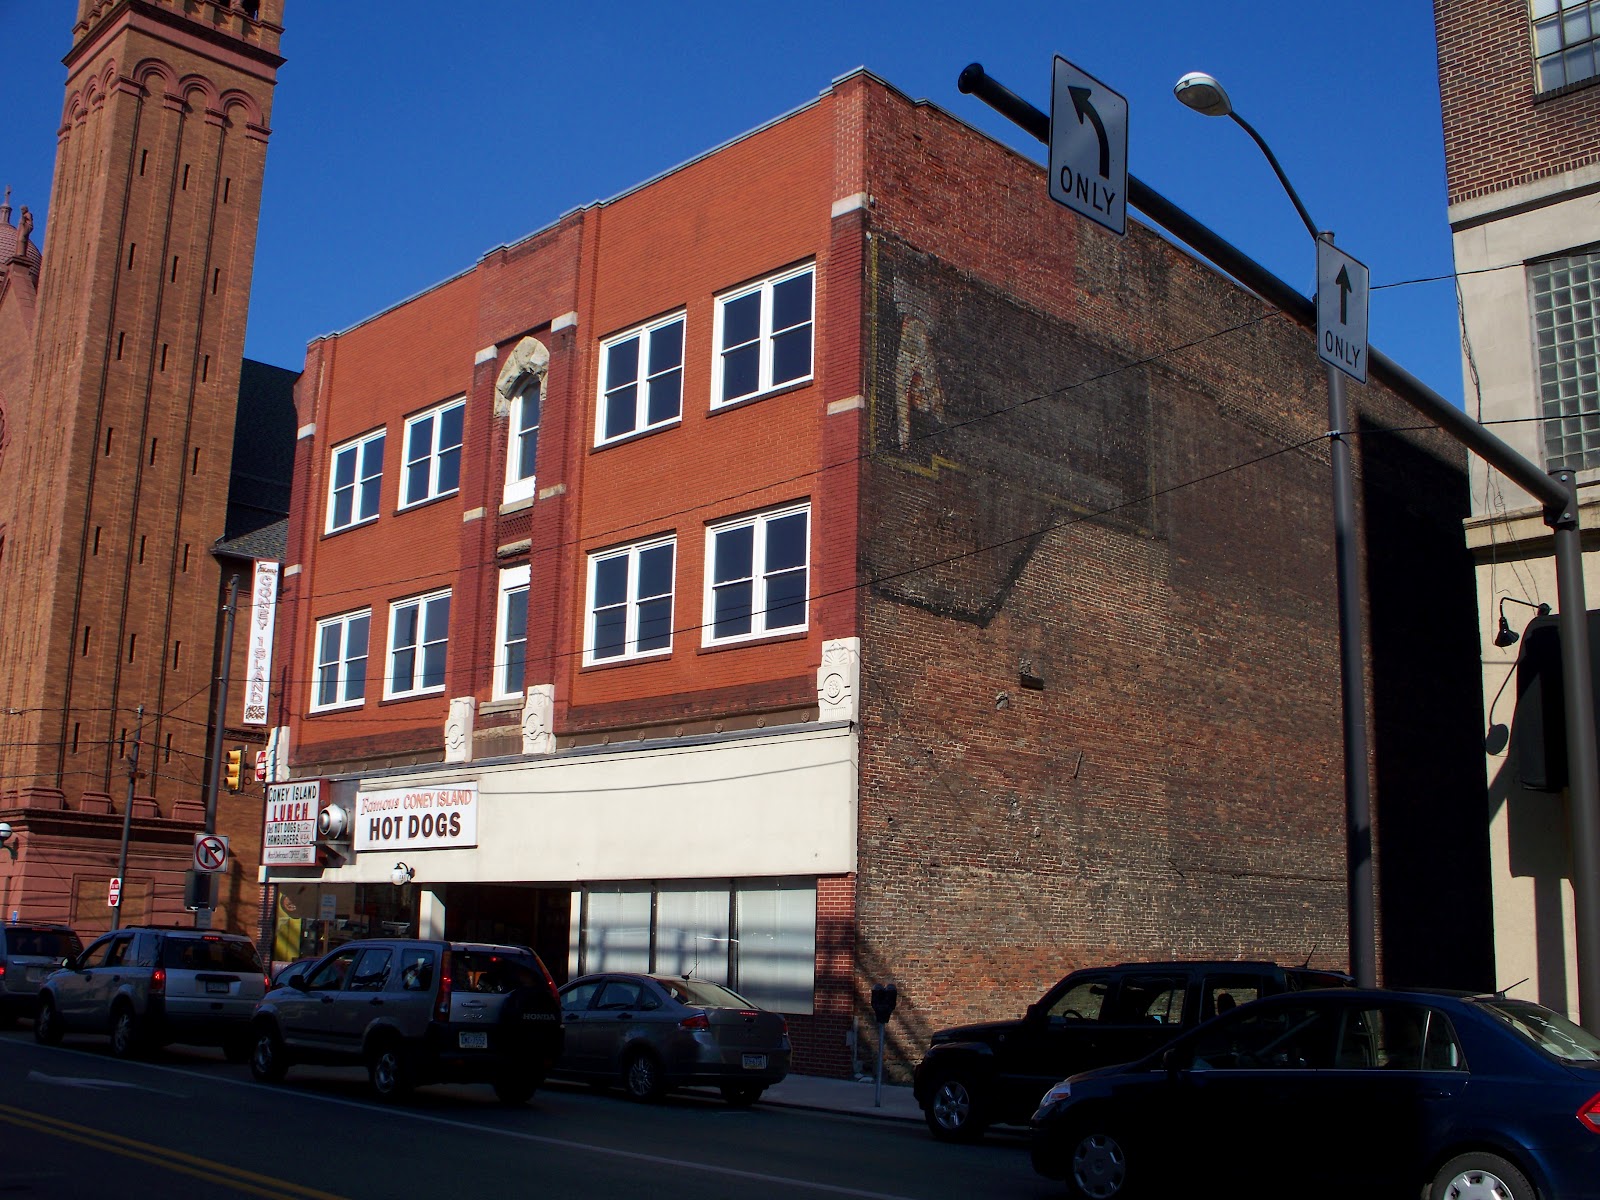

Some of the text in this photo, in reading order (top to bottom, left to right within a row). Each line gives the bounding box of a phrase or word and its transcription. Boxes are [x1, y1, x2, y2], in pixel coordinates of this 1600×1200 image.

[1060, 165, 1116, 216] ONLY
[1324, 329, 1361, 366] ONLY
[268, 785, 317, 802] CONEY ISLAND
[360, 789, 473, 816] Famous CONEY ISLAND
[273, 802, 309, 822] LUNCH
[274, 822, 283, 833] HOT
[284, 822, 296, 833] DOGS
[369, 811, 462, 841] HOT DOGS
[522, 1012, 557, 1021] HONDA
